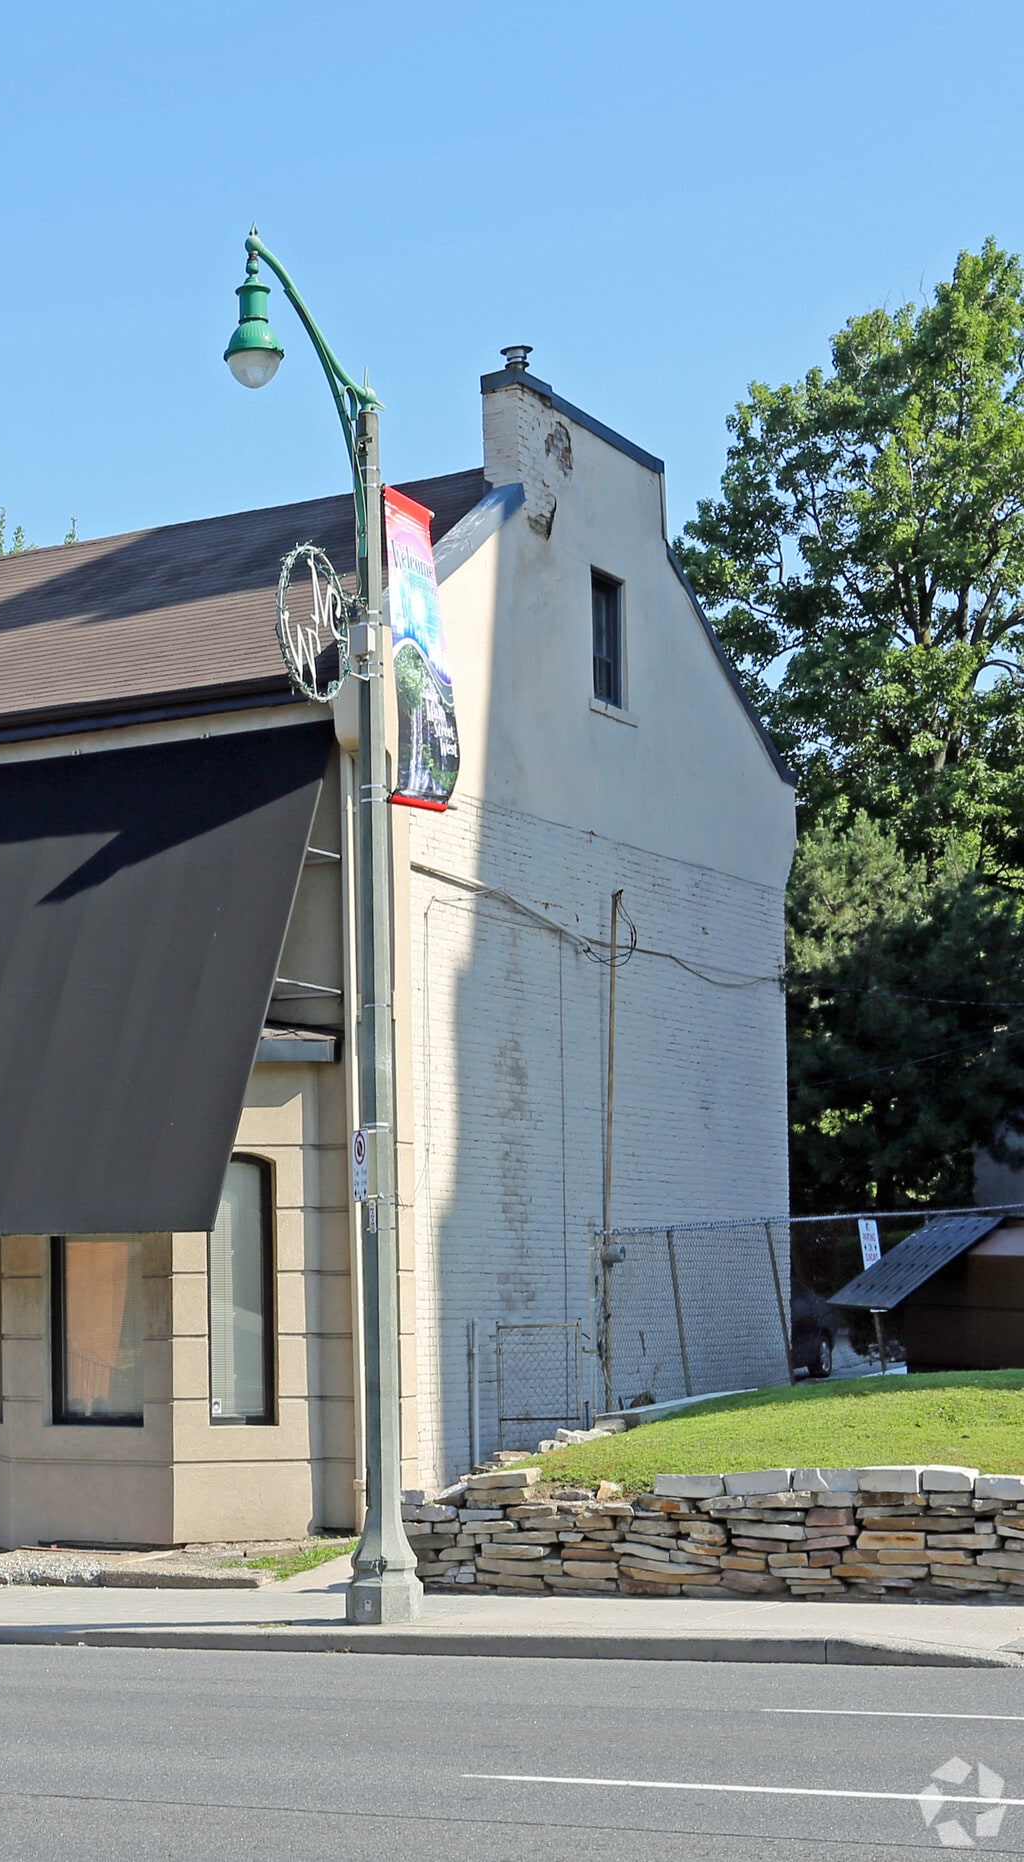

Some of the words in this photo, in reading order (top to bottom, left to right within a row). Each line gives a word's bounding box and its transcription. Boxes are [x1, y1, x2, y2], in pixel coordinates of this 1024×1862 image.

[391, 539, 434, 581] Welcome
[425, 699, 446, 722] Main
[433, 719, 455, 741] Street
[439, 737, 458, 758] West
